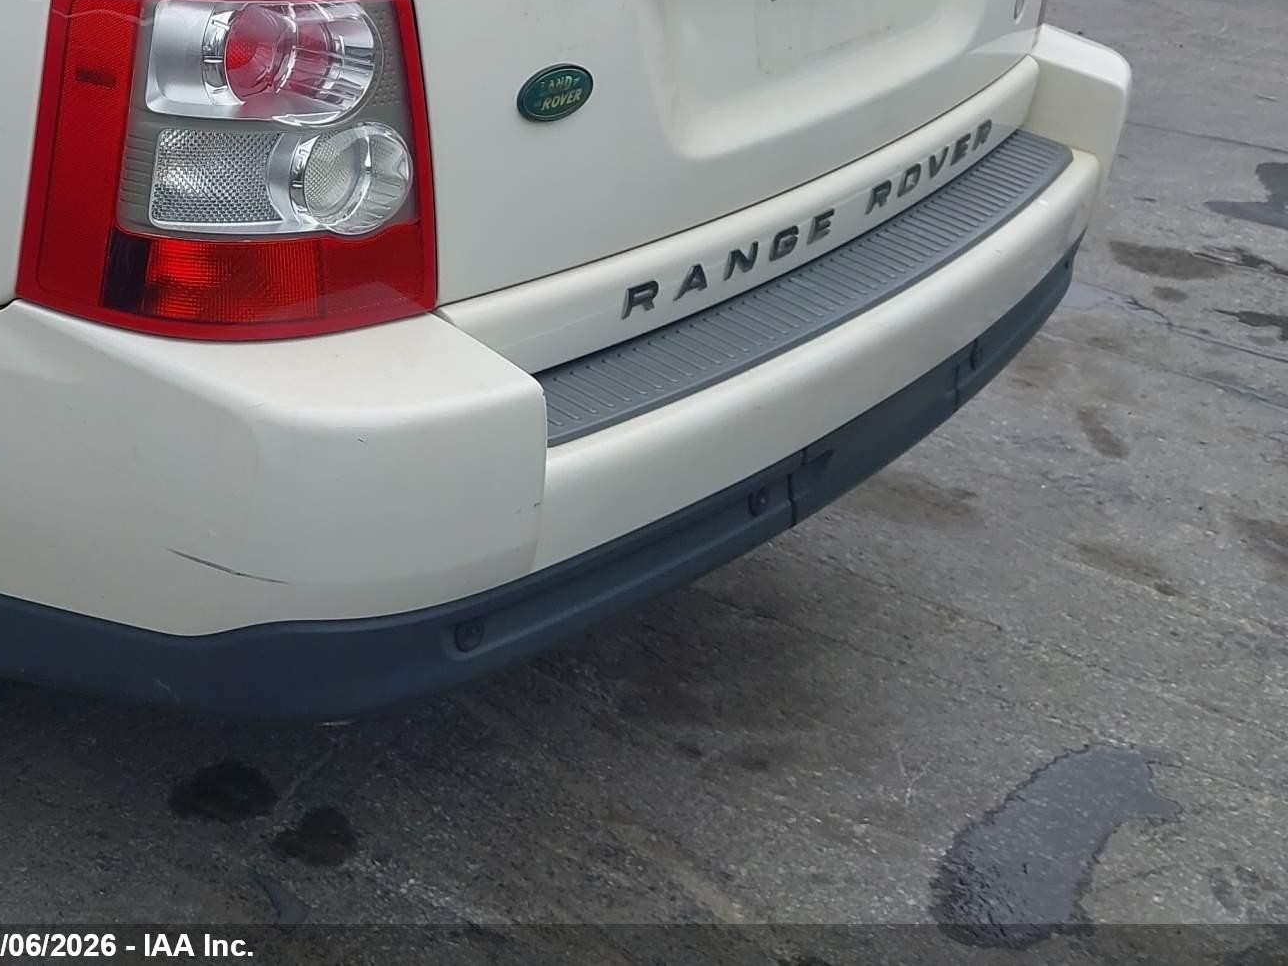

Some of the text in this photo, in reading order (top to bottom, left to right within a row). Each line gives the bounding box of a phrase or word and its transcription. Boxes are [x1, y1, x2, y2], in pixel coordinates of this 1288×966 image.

[541, 88, 582, 111] ROVER
[621, 118, 992, 320] RANGE ROVER
